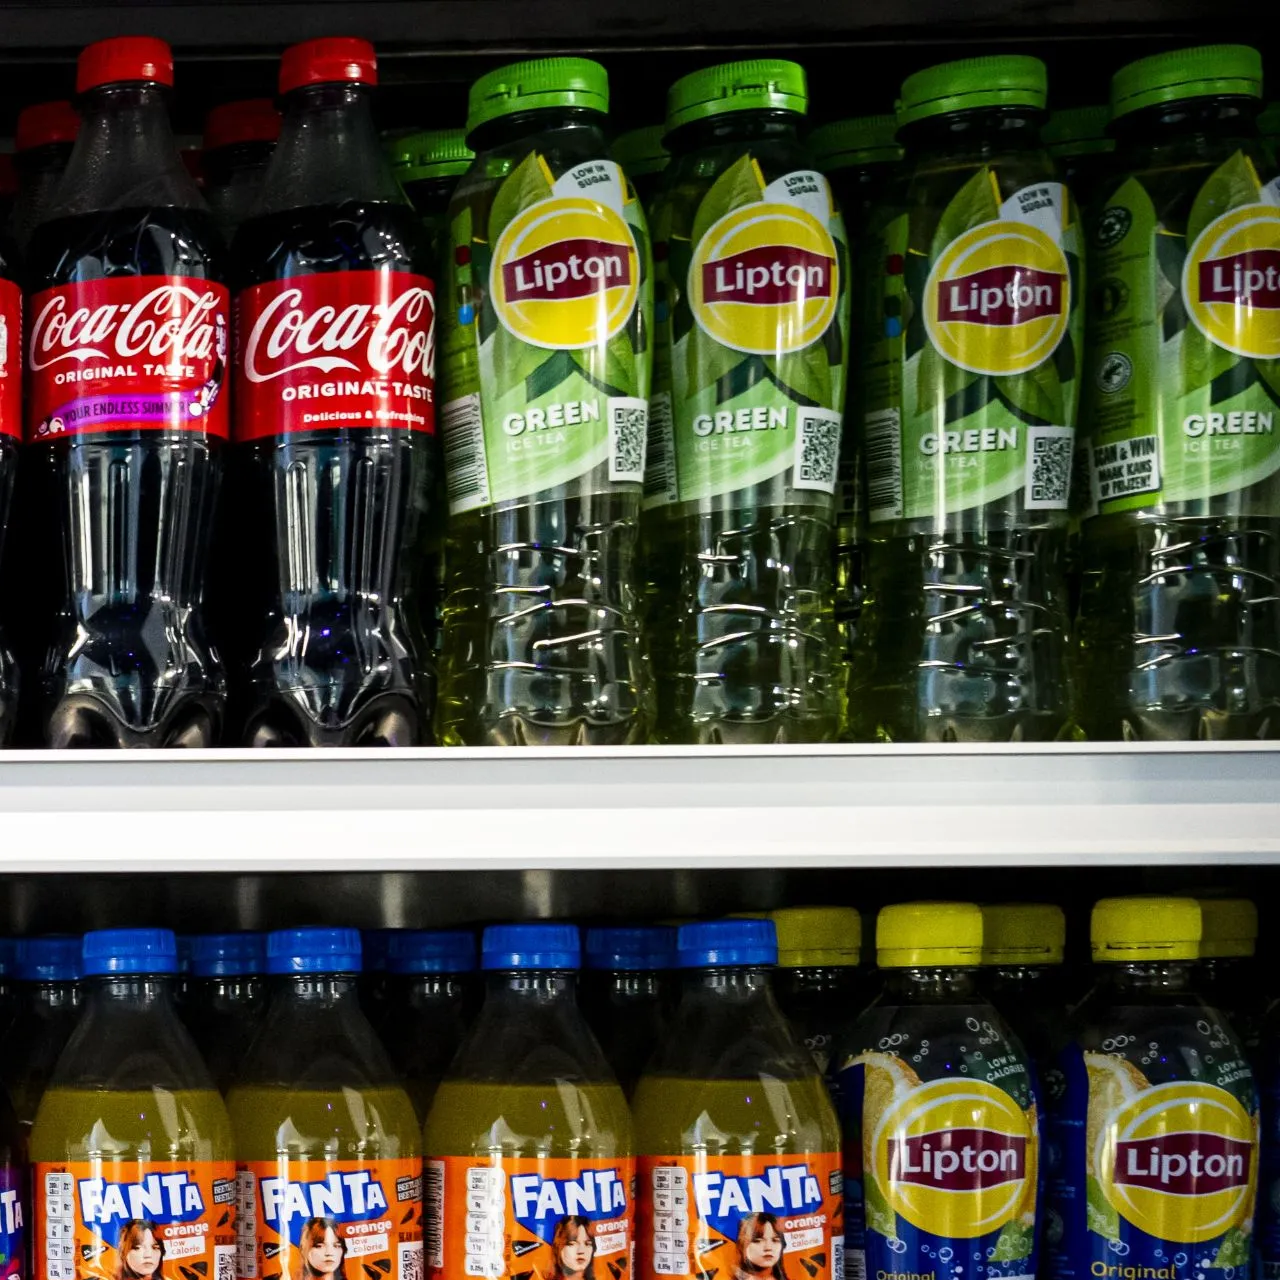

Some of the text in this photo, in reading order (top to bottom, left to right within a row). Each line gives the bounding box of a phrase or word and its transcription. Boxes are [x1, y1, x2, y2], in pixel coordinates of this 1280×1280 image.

[571, 164, 606, 180] LOW IN
[577, 172, 612, 189] SUGAR
[784, 176, 803, 188] LOW
[788, 181, 819, 195] SUGAR
[1021, 198, 1054, 215] SUGAR
[515, 254, 623, 292] Lipton
[714, 260, 824, 296] Lipton
[1212, 264, 1280, 299] Lipt
[949, 280, 1053, 316] Lipton
[28, 285, 221, 372] Coca-Cola
[54, 363, 196, 384] ORIGINAL TASTE
[281, 382, 433, 402] ORIGINAL TASTE
[92, 401, 141, 419] ENDLESS
[303, 411, 362, 423] Delicious
[502, 400, 601, 437] GREEN
[692, 405, 789, 438] GREEN
[1182, 411, 1274, 438] GREEN
[505, 432, 566, 452] ICE TEA
[724, 436, 753, 448] TEA
[918, 427, 1019, 456] GREEN
[1129, 437, 1155, 459] WIN
[1214, 438, 1241, 450] TEA
[949, 455, 978, 469] TEA
[987, 1056, 1008, 1070] LOW
[986, 1064, 1026, 1083] CALORIES
[901, 1143, 1018, 1181] Lipton
[1127, 1147, 1243, 1184] Lipton
[79, 1174, 204, 1224] FANTA
[261, 1174, 386, 1222] FANTA
[512, 1168, 627, 1220] FANTA
[693, 1166, 822, 1217] FANTA
[164, 1221, 210, 1237] orange
[345, 1220, 393, 1237] orange
[595, 1219, 629, 1233] orange
[783, 1215, 828, 1229] orange
[170, 1245, 201, 1256] calorie
[350, 1237, 369, 1247] low
[352, 1242, 384, 1255] calorie
[791, 1236, 820, 1247] calorie
